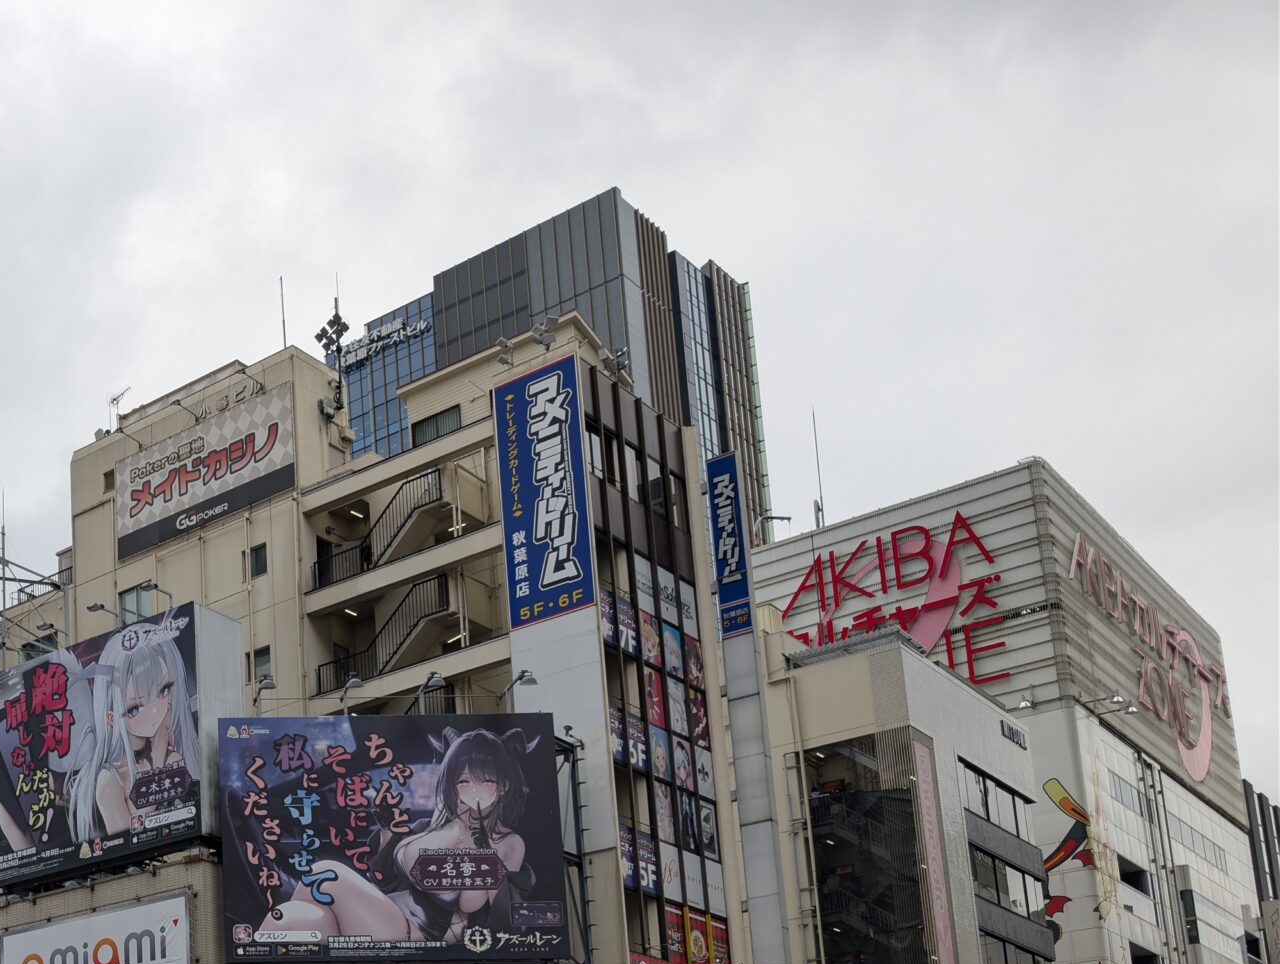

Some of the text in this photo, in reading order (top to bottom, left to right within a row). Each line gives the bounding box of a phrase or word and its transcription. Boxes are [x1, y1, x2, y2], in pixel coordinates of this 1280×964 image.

[129, 435, 206, 484] Pokerの聖地
[129, 421, 279, 518] メイドカジノ
[505, 400, 523, 512] トレーディングカードゲーム
[526, 370, 583, 592] アメニティードリーム
[512, 530, 530, 599] 秋葉原店
[780, 510, 997, 620] AKIBA
[619, 624, 636, 653] 7F
[30, 662, 76, 760] 絶対
[365, 733, 415, 834] ちゃんと
[273, 732, 338, 906] 私に守らせて
[423, 876, 496, 887] CV 野村香菜子
[440, 862, 477, 877] 名寄
[639, 860, 657, 889] 5F
[257, 932, 288, 940] アズレン
[288, 944, 320, 952] Google Play
[495, 930, 563, 950] アズールレーン
